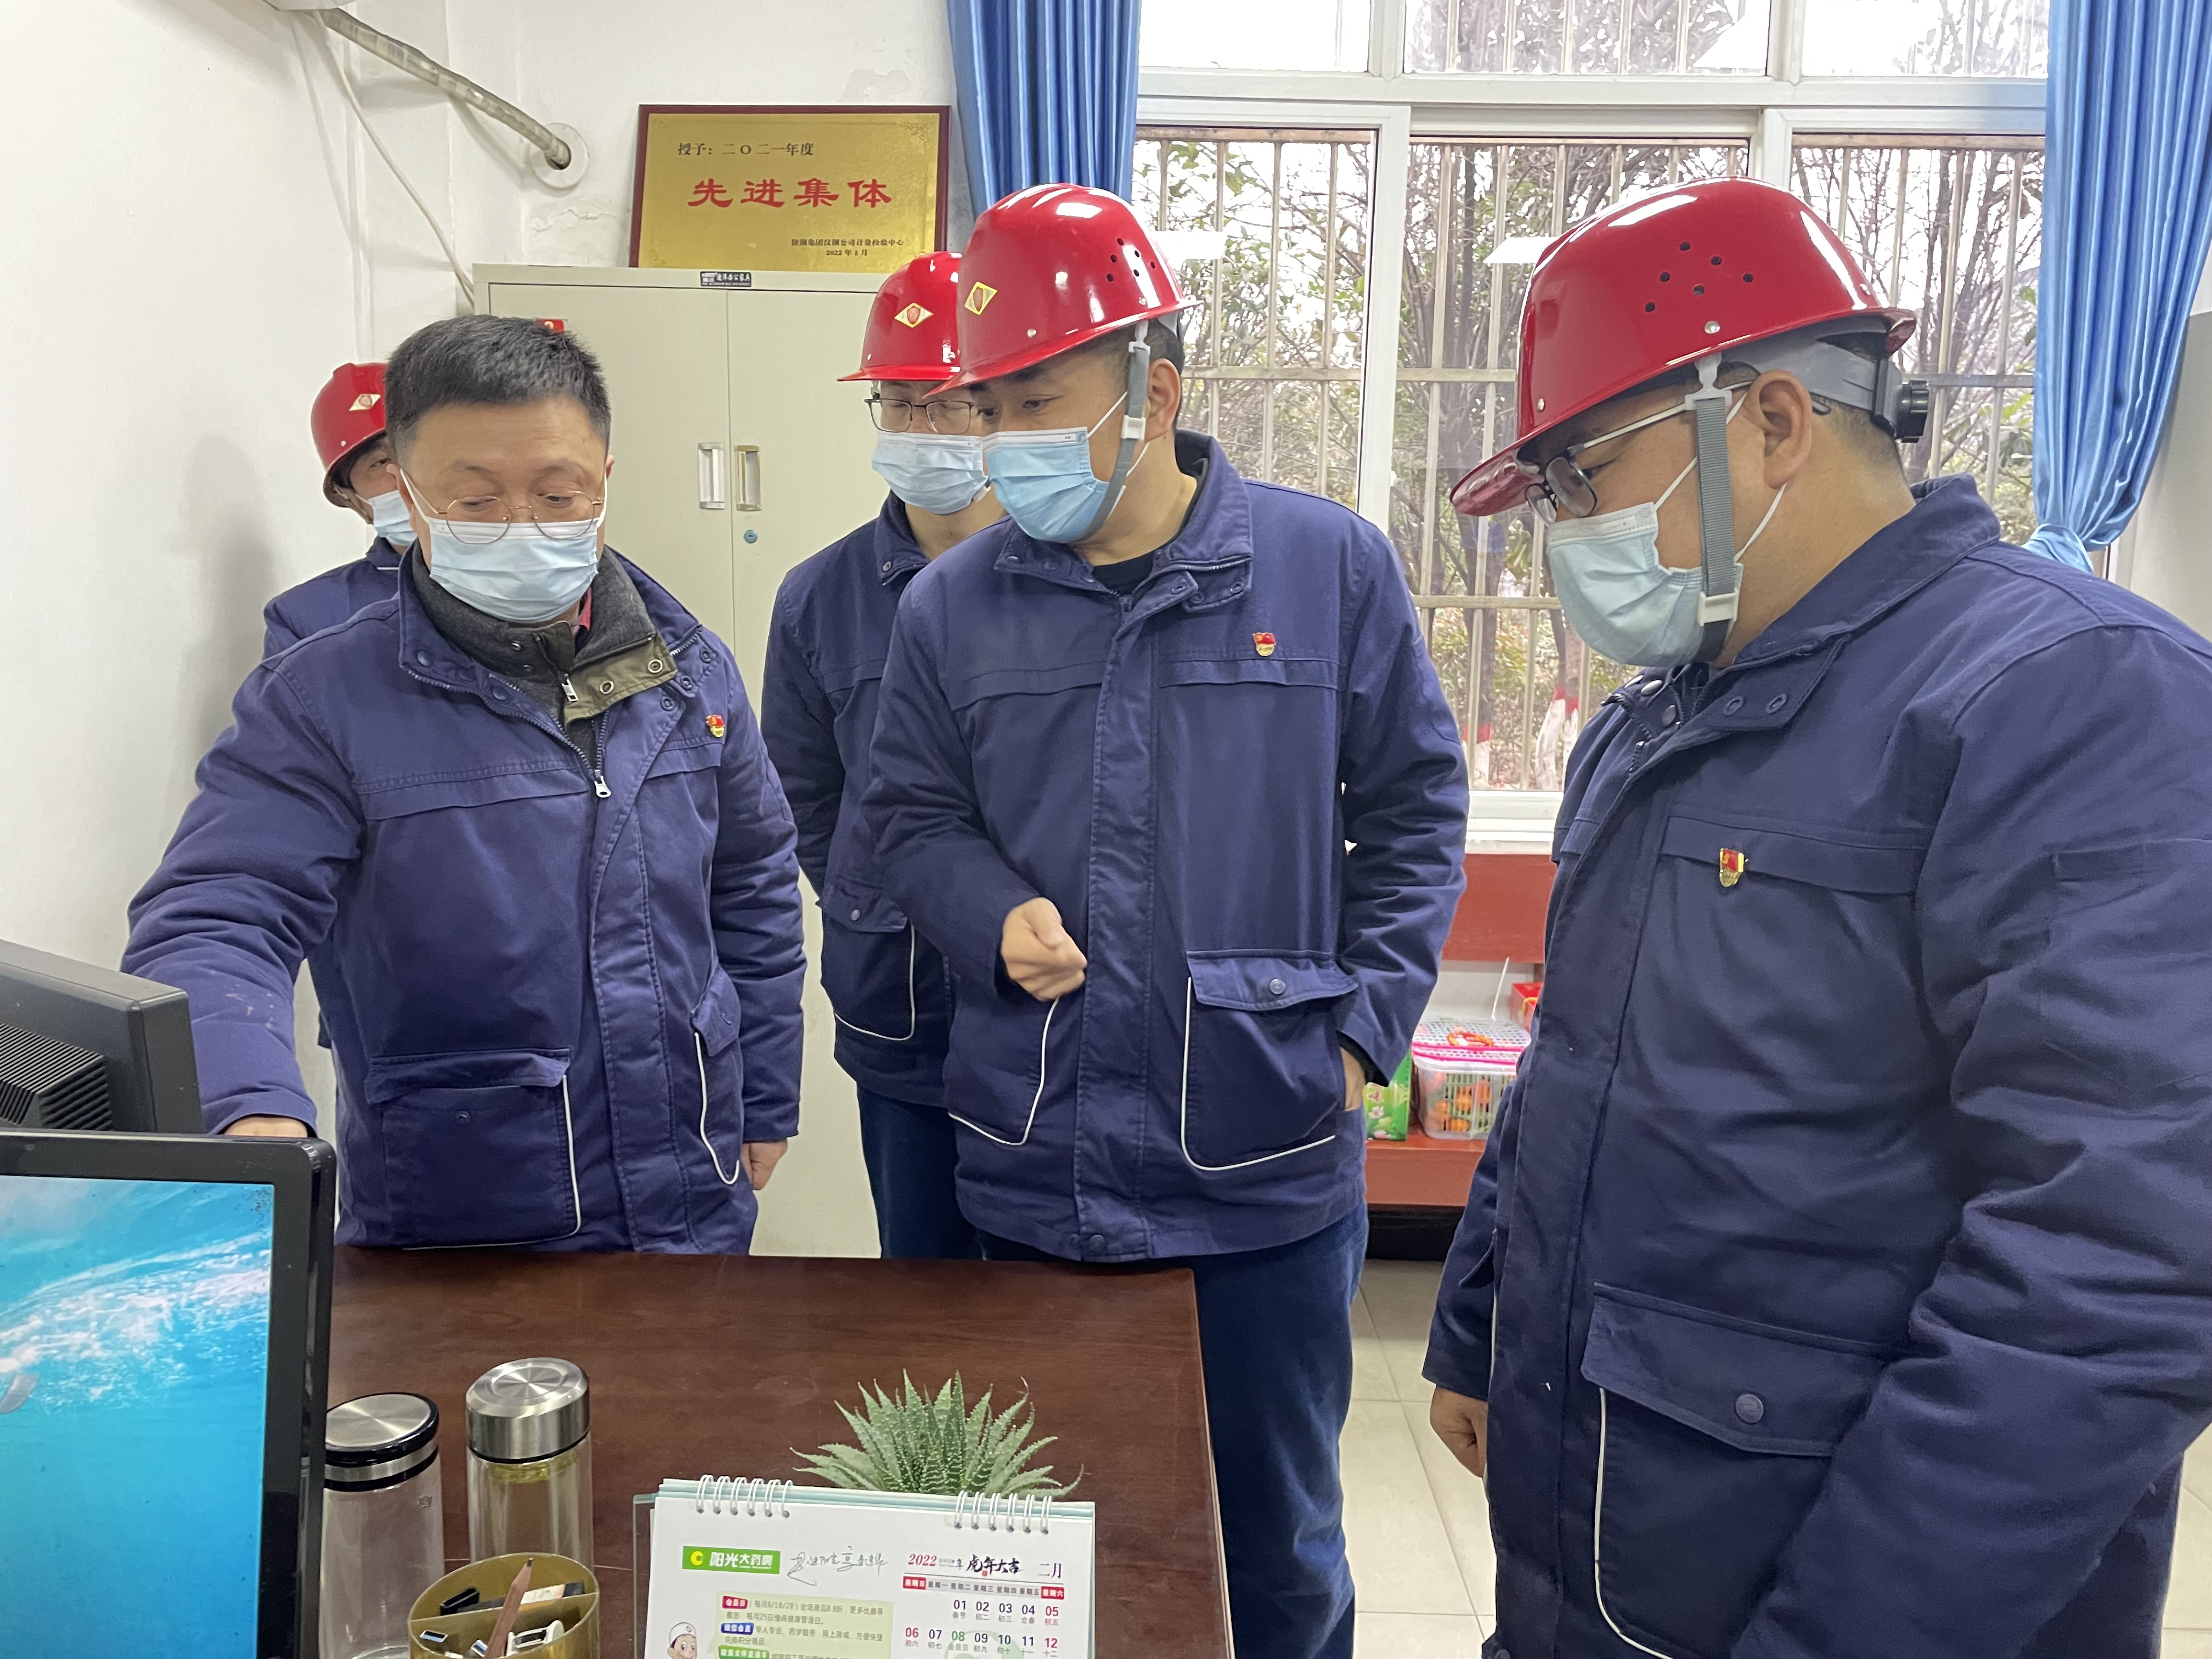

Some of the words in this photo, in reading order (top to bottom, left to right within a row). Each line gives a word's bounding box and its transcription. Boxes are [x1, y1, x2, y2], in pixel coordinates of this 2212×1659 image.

[687, 178, 891, 208] 先进集体
[908, 1554, 937, 1566] 2022
[966, 1554, 1021, 1575] 虎年大吉
[1038, 1562, 1062, 1579] 二月
[953, 1599, 967, 1610] 01
[976, 1601, 990, 1612] 02
[998, 1603, 1012, 1613] 03
[1022, 1605, 1035, 1615] 04
[1045, 1606, 1059, 1617] 05
[905, 1627, 919, 1638] 06
[928, 1629, 943, 1640] 07
[951, 1630, 965, 1641] 08
[974, 1632, 988, 1643] 09
[998, 1634, 1011, 1645] 10
[1022, 1636, 1035, 1647] 11
[1045, 1638, 1058, 1649] 12
